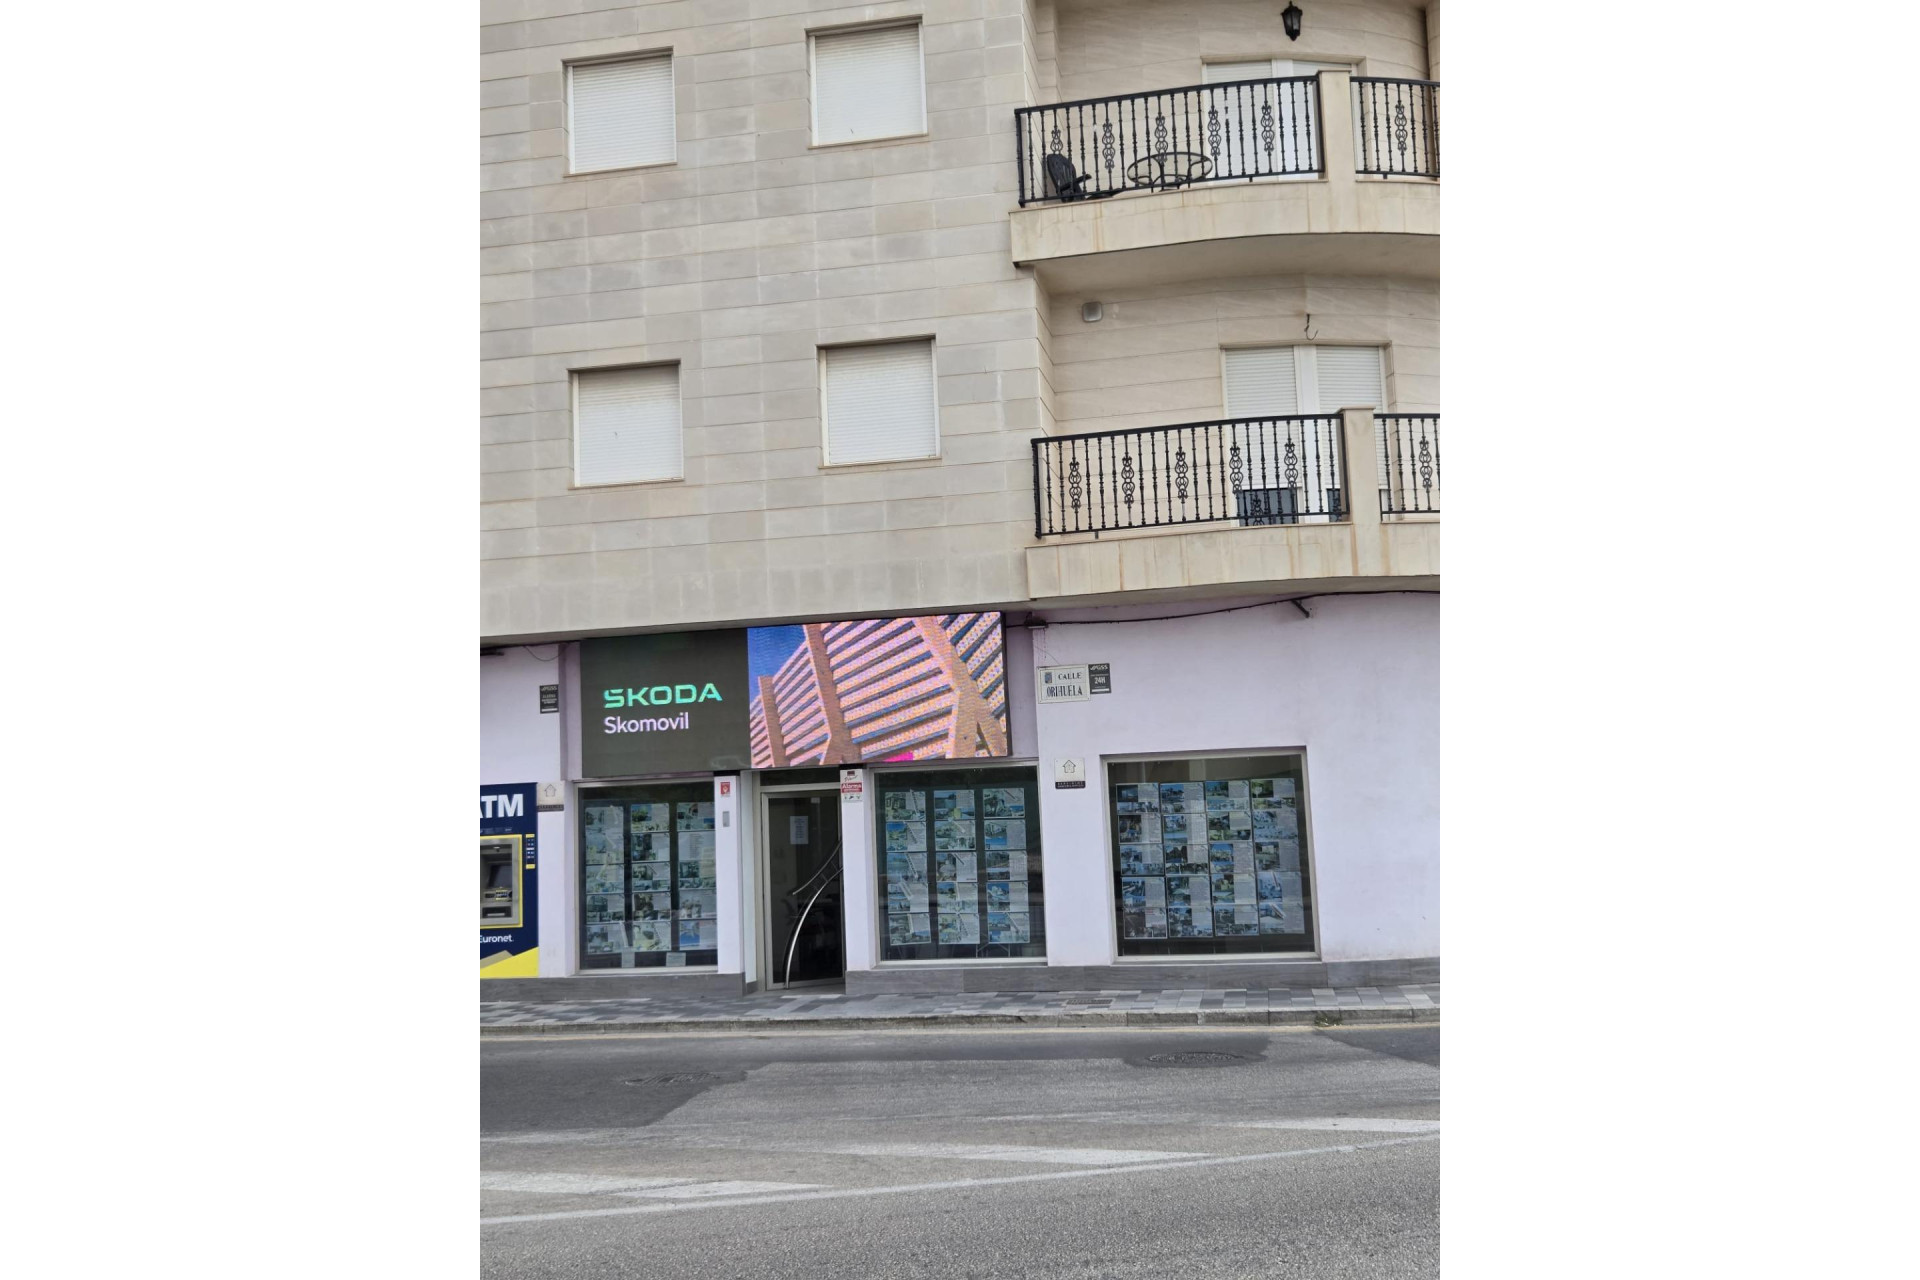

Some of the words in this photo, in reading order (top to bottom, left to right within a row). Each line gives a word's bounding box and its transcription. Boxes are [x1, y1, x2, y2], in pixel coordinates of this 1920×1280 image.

[1058, 672, 1082, 680] CALLE
[1046, 684, 1083, 698] ORIHUELA
[604, 712, 689, 734] Skomovil
[480, 793, 524, 818] TM
